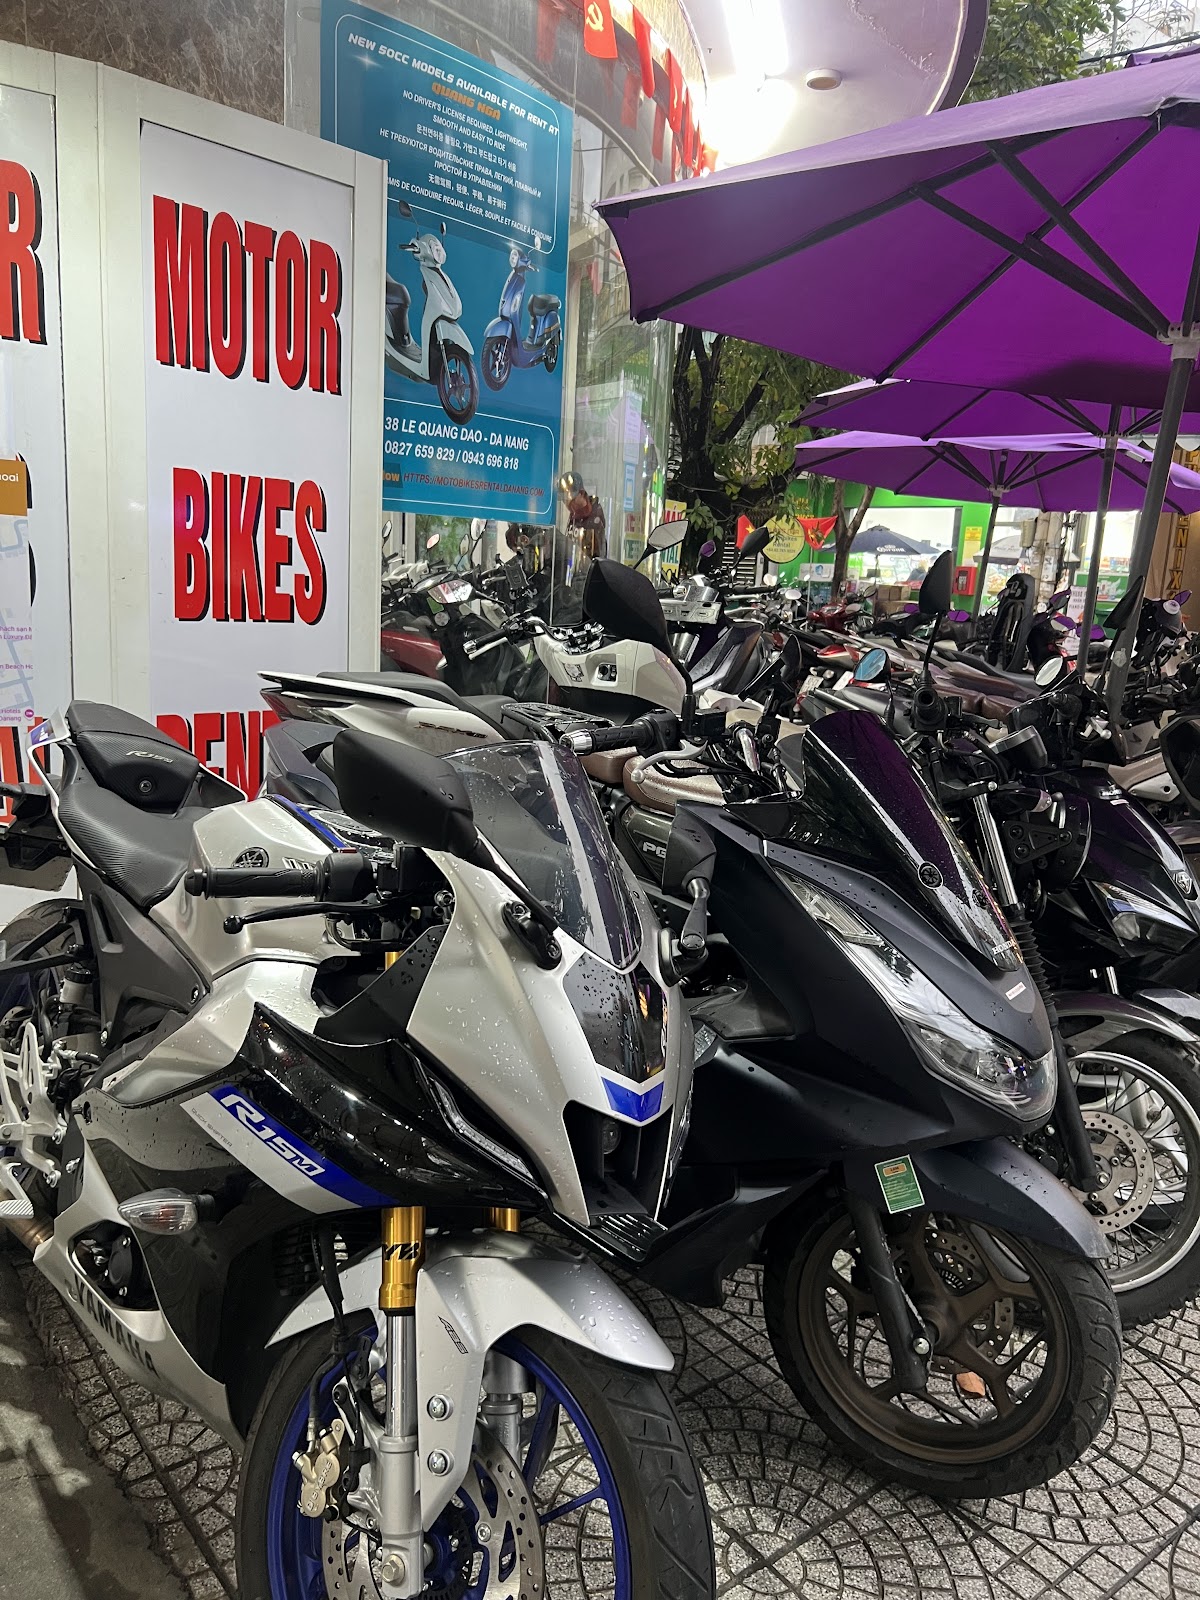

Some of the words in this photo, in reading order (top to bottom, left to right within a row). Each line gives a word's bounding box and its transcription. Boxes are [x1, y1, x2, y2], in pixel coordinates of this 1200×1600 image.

[348, 33, 376, 50] NEW
[412, 58, 454, 83] MODELS
[456, 78, 508, 109] AVAILABLE
[509, 103, 526, 118] FOR
[527, 112, 548, 130] RENT
[548, 124, 558, 136] AT
[432, 82, 474, 108] QUANG
[477, 102, 500, 120] NGA
[402, 90, 413, 100] NO
[414, 94, 441, 112] DRIVER'S
[442, 105, 466, 122] LICENSE
[466, 116, 494, 134] REQUIRED,
[494, 129, 528, 151] LIGHTWEIGHT,
[432, 114, 458, 131] SMOOTH
[459, 125, 471, 136] AND
[472, 131, 486, 144] EASY
[486, 136, 494, 146] TO
[494, 140, 506, 152] RIDE
[380, 128, 390, 138] НЕ
[390, 132, 428, 152] ТРЕБУЮТСЯ
[428, 146, 474, 170] ВОДИТЕЛЬСКИЕ
[474, 164, 493, 178] ПРАВА,
[434, 160, 462, 176] ПРОСТОЙ
[468, 173, 502, 192] УПРАВЛЕНИИ
[401, 182, 410, 190] DE
[410, 184, 442, 202] CONDUIRE
[442, 195, 464, 210] REQUIS,
[466, 202, 484, 217] LÉGER,
[484, 210, 504, 224] SOUPLE
[504, 218, 510, 226] ET
[511, 221, 527, 234] FACILE
[531, 228, 552, 243] CONDUIRE
[152, 194, 343, 396] MOTOR
[384, 416, 399, 432] 38
[402, 420, 416, 434] LE
[418, 422, 458, 440] QUANG
[460, 428, 482, 443] DAO
[490, 434, 502, 446] DA
[504, 436, 530, 451] NANG
[384, 440, 412, 456] 0827
[414, 444, 434, 459] 659
[436, 448, 455, 462] 829
[456, 450, 461, 462] /
[462, 451, 484, 466] 0943
[486, 455, 502, 468] 696
[504, 457, 519, 470] 818
[172, 467, 328, 626] BIKES
[876, 545, 906, 553] Corona
[191, 1108, 208, 1126] QUICK
[206, 1124, 233, 1148] SHIFTER
[220, 1093, 326, 1177] R15M
[75, 1273, 160, 1379] YAMAHA
